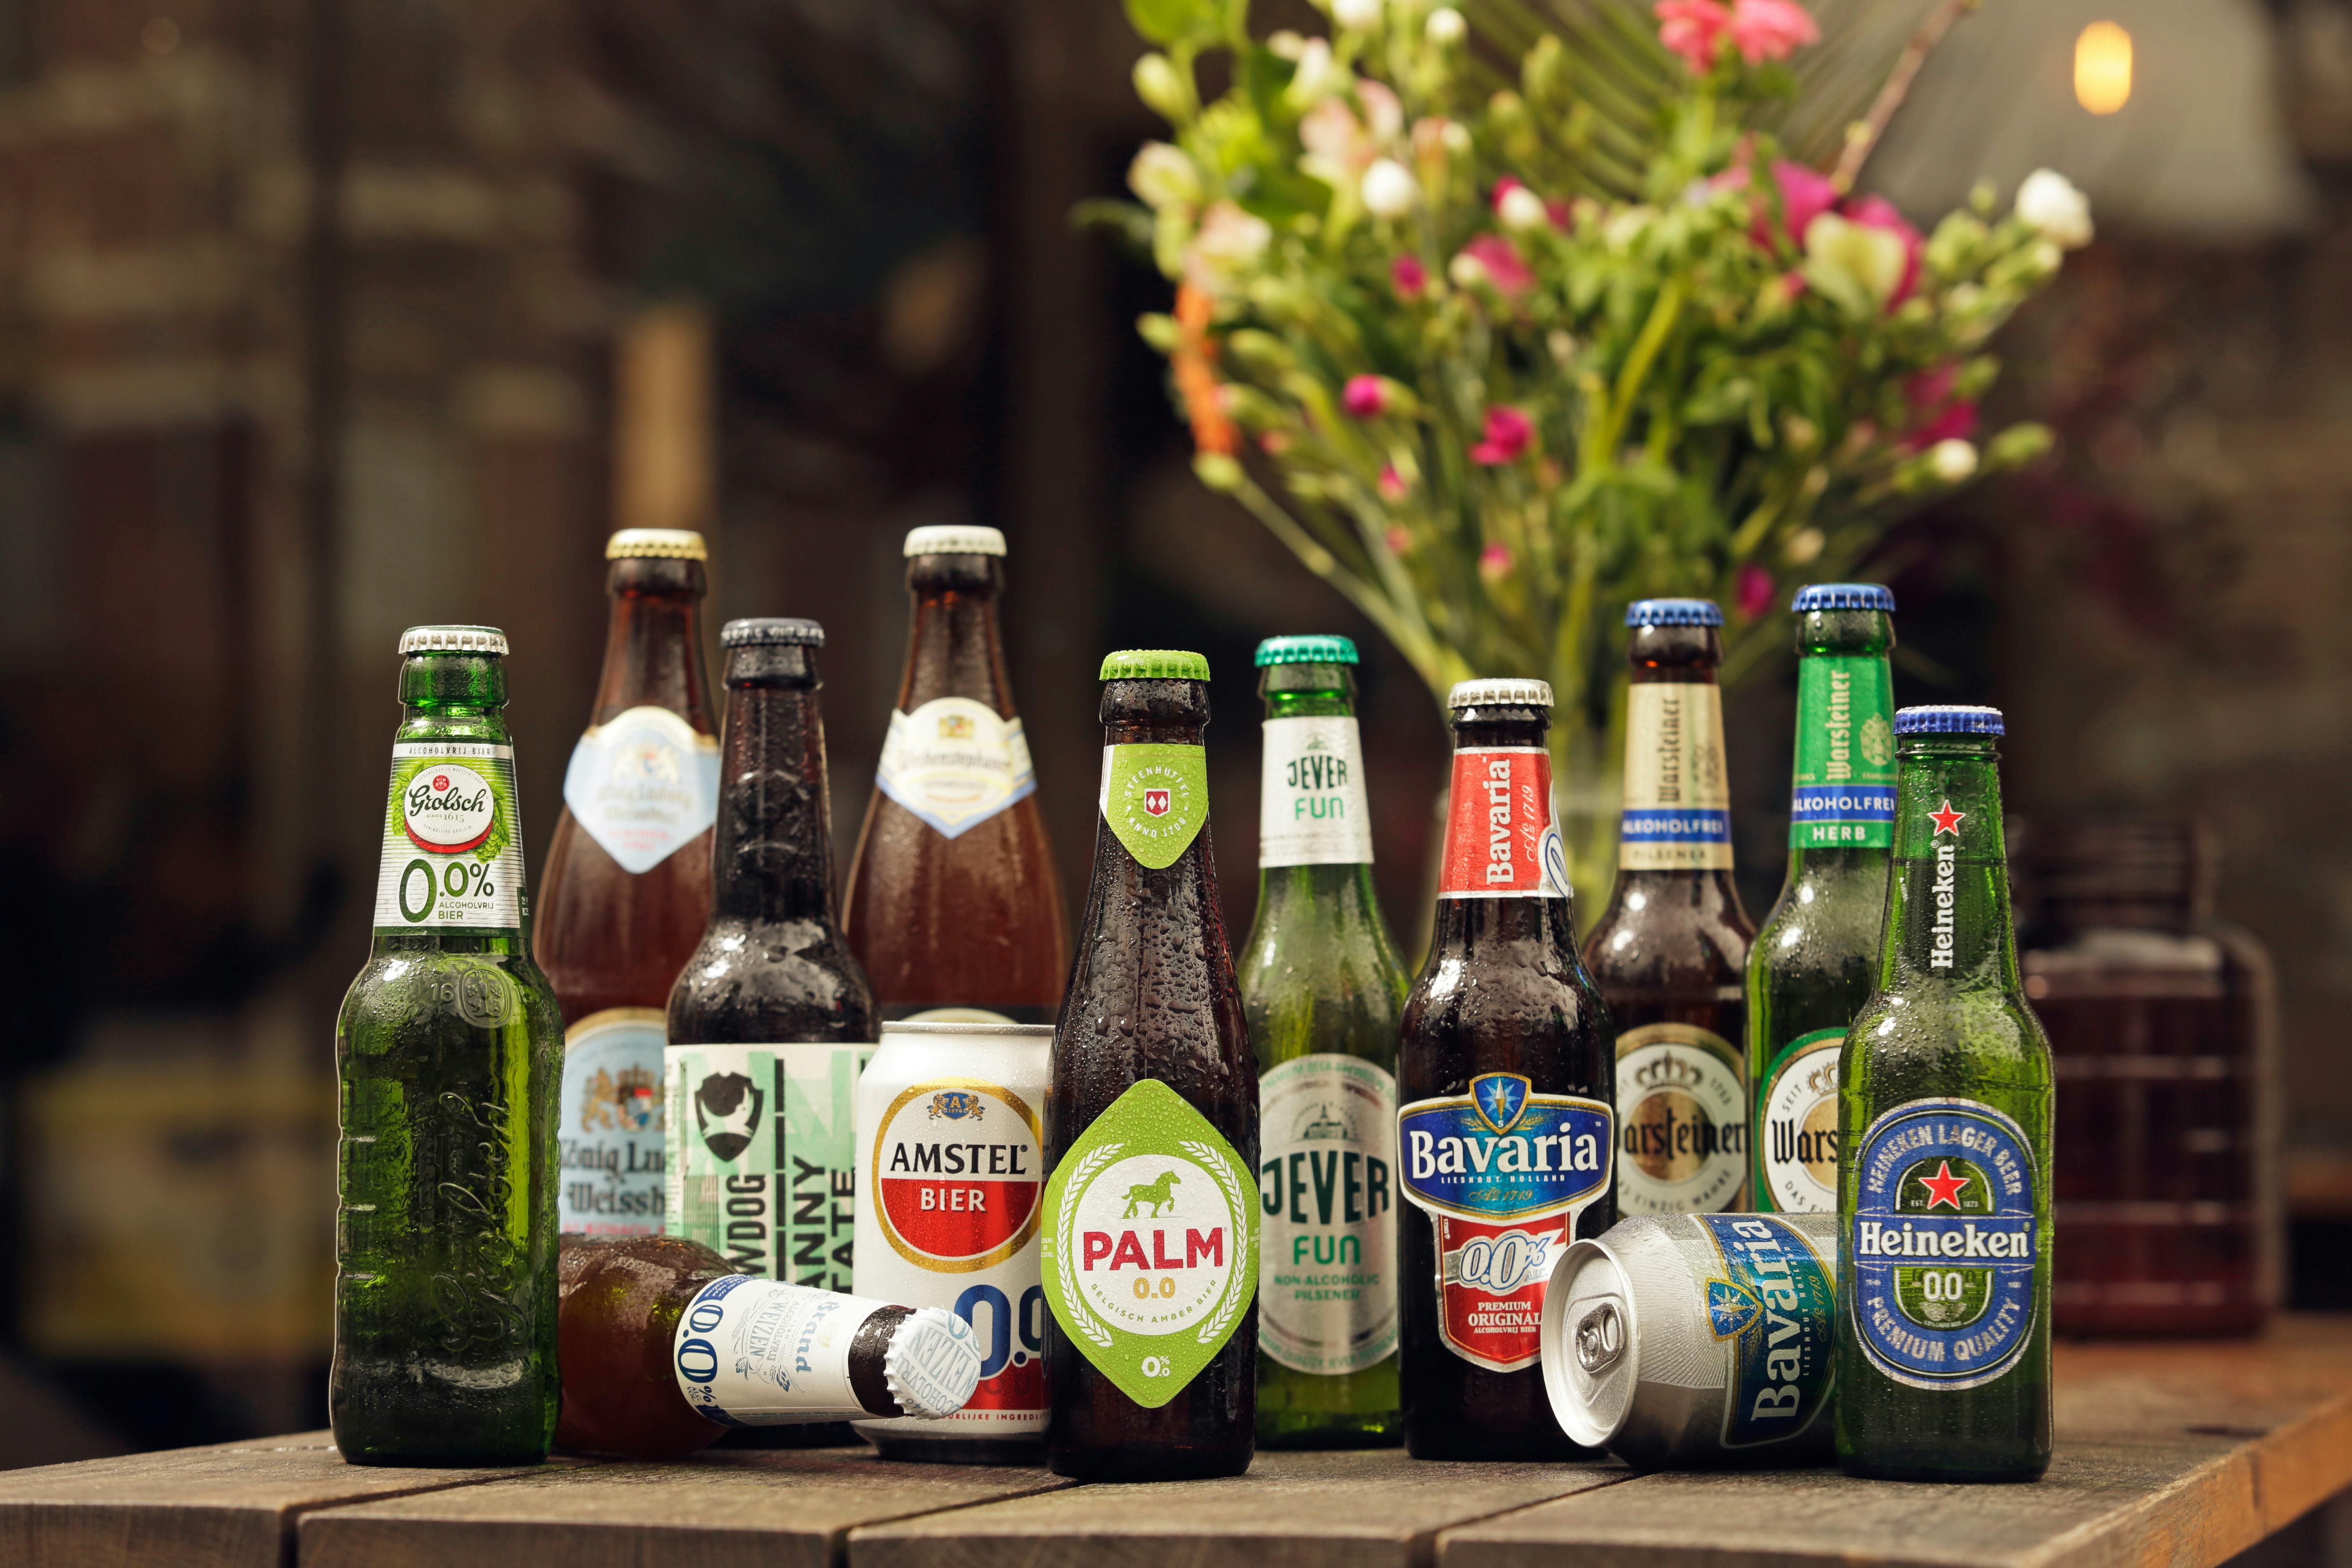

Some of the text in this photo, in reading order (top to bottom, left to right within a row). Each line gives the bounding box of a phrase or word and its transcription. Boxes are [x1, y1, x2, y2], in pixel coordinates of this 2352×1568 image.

[1825, 670, 1851, 781] Warsteiner
[1125, 766, 1189, 798] STEENHUFFEL
[1287, 755, 1347, 789] JEVER
[409, 784, 487, 817] Grolsch
[443, 812, 464, 823] 1615
[1521, 785, 1535, 820] 1719
[1793, 796, 1894, 812] ALKOHOLFREI
[1128, 817, 1157, 838] ANNO
[1483, 759, 1514, 885] Bavaria
[1812, 826, 1867, 841] HERB
[399, 859, 494, 923] 0.0%
[439, 901, 494, 909] ALCOHOLVRIJ
[1931, 844, 1955, 969] Heineken
[438, 910, 463, 920] BIER
[1782, 1083, 1802, 1113] SEIT
[1410, 1122, 1599, 1179] Bavaria
[1617, 1107, 1746, 1160] arsteiner
[890, 1142, 1027, 1175] AMSTEL
[1867, 1124, 2022, 1196] HEINEKEN LAGER BEER
[1261, 1150, 1389, 1225] JEVER
[1503, 1190, 1533, 1201] 1719
[1510, 1174, 1565, 1183] HOLLAND
[1785, 1181, 1805, 1206] DAS
[921, 1188, 987, 1212] BIER
[1083, 1227, 1223, 1270] PALM
[1860, 1221, 2029, 1258] Heineken
[1460, 1235, 1552, 1290] 0.0%
[1091, 1279, 1217, 1323] BELGISCH AMBER BIER
[1133, 1277, 1176, 1299] 0.0
[1294, 1289, 1360, 1300] PILSENER
[1477, 1301, 1532, 1312] PREMIUM
[749, 1298, 790, 1359] WEIZEN
[766, 1300, 800, 1362] ALCOHOLVRIJ
[795, 1301, 840, 1374] Brand
[1468, 1312, 1542, 1327] ORIGINAL
[1732, 1221, 1801, 1421] Bavaria
[1867, 1296, 2020, 1362] PREMIUM QUALITY
[677, 1304, 724, 1403] 0.0%
[1802, 1308, 1811, 1376] LIESHOUT
[906, 1324, 980, 1401] WEIZEN
[892, 1352, 962, 1416] LCOHOLVRIJ
